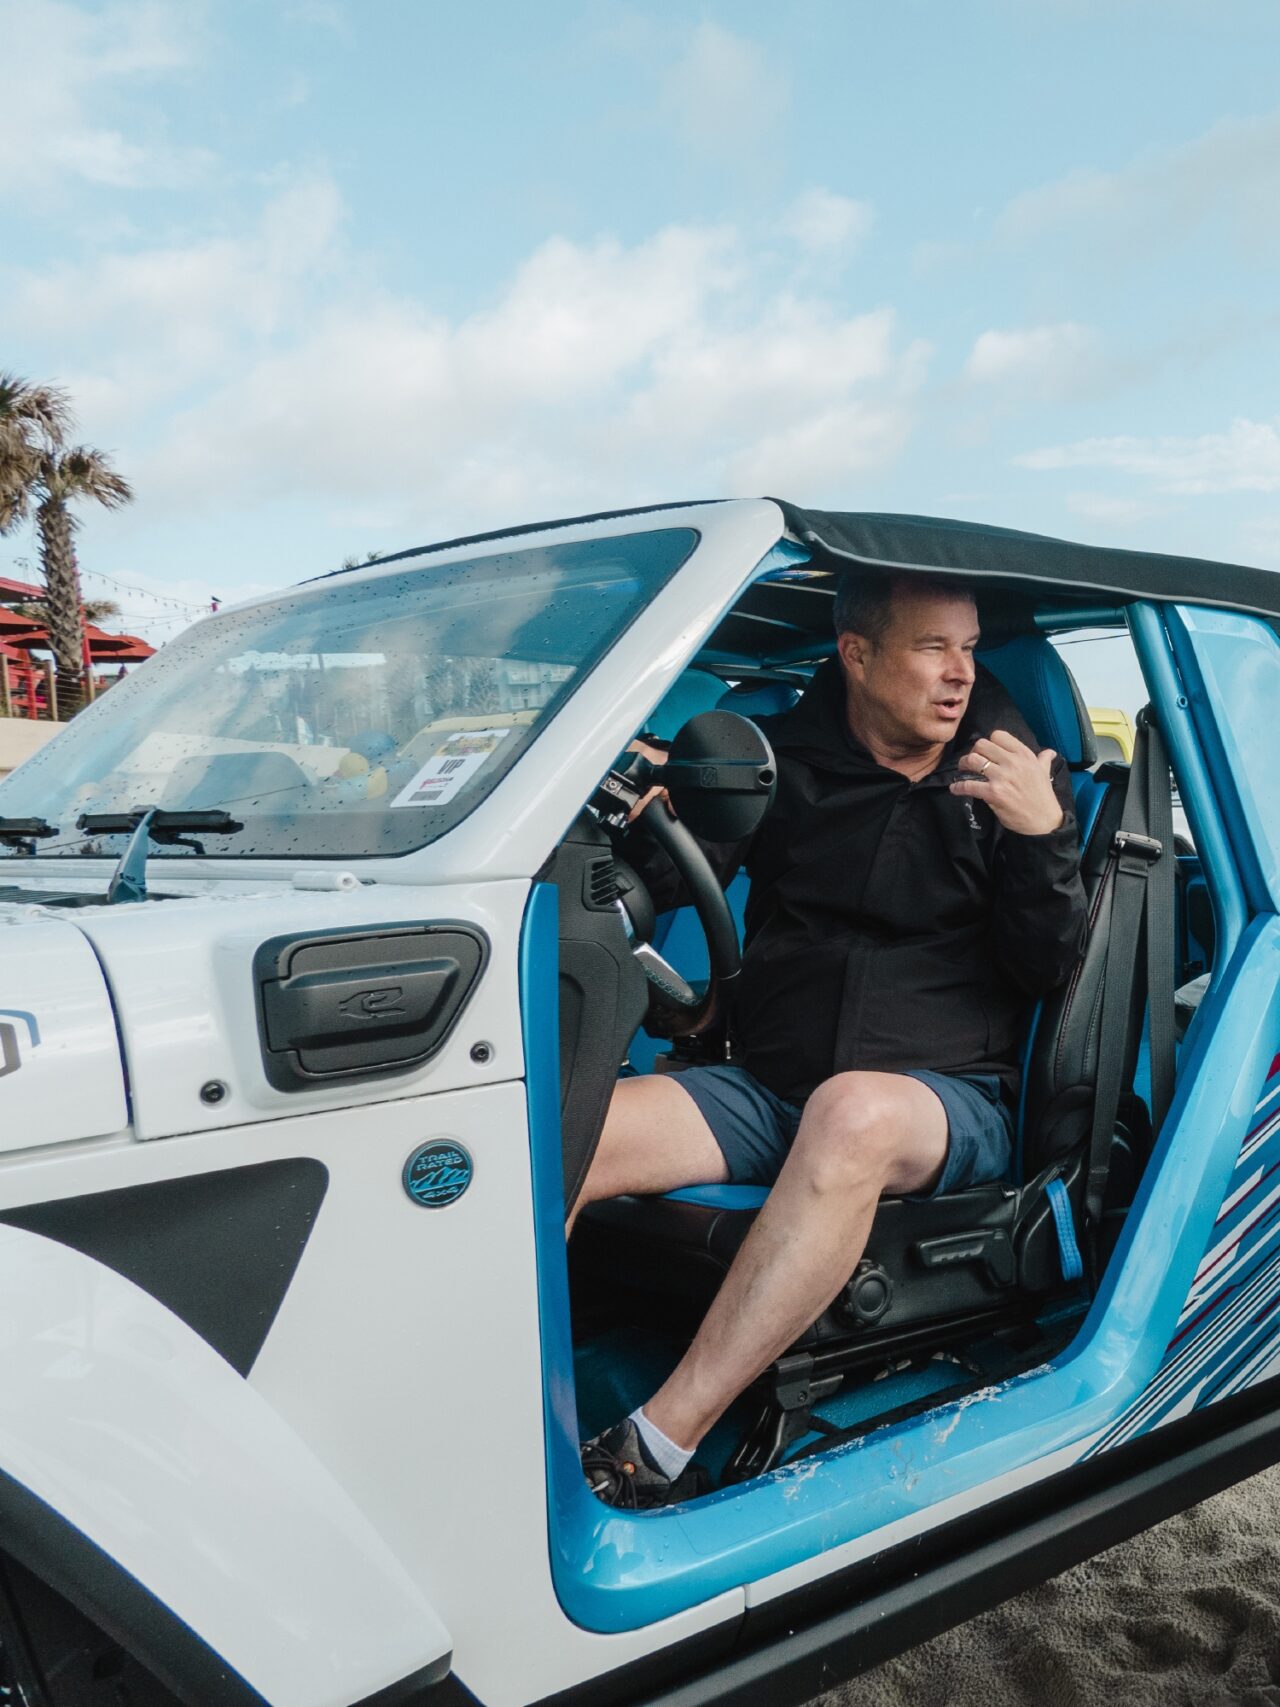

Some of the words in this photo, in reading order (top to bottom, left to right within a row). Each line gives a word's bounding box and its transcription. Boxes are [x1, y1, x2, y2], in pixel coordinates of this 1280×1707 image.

[437, 759, 465, 774] VIP
[416, 1156, 463, 1171] RATED
[419, 1152, 459, 1163] TRAIL
